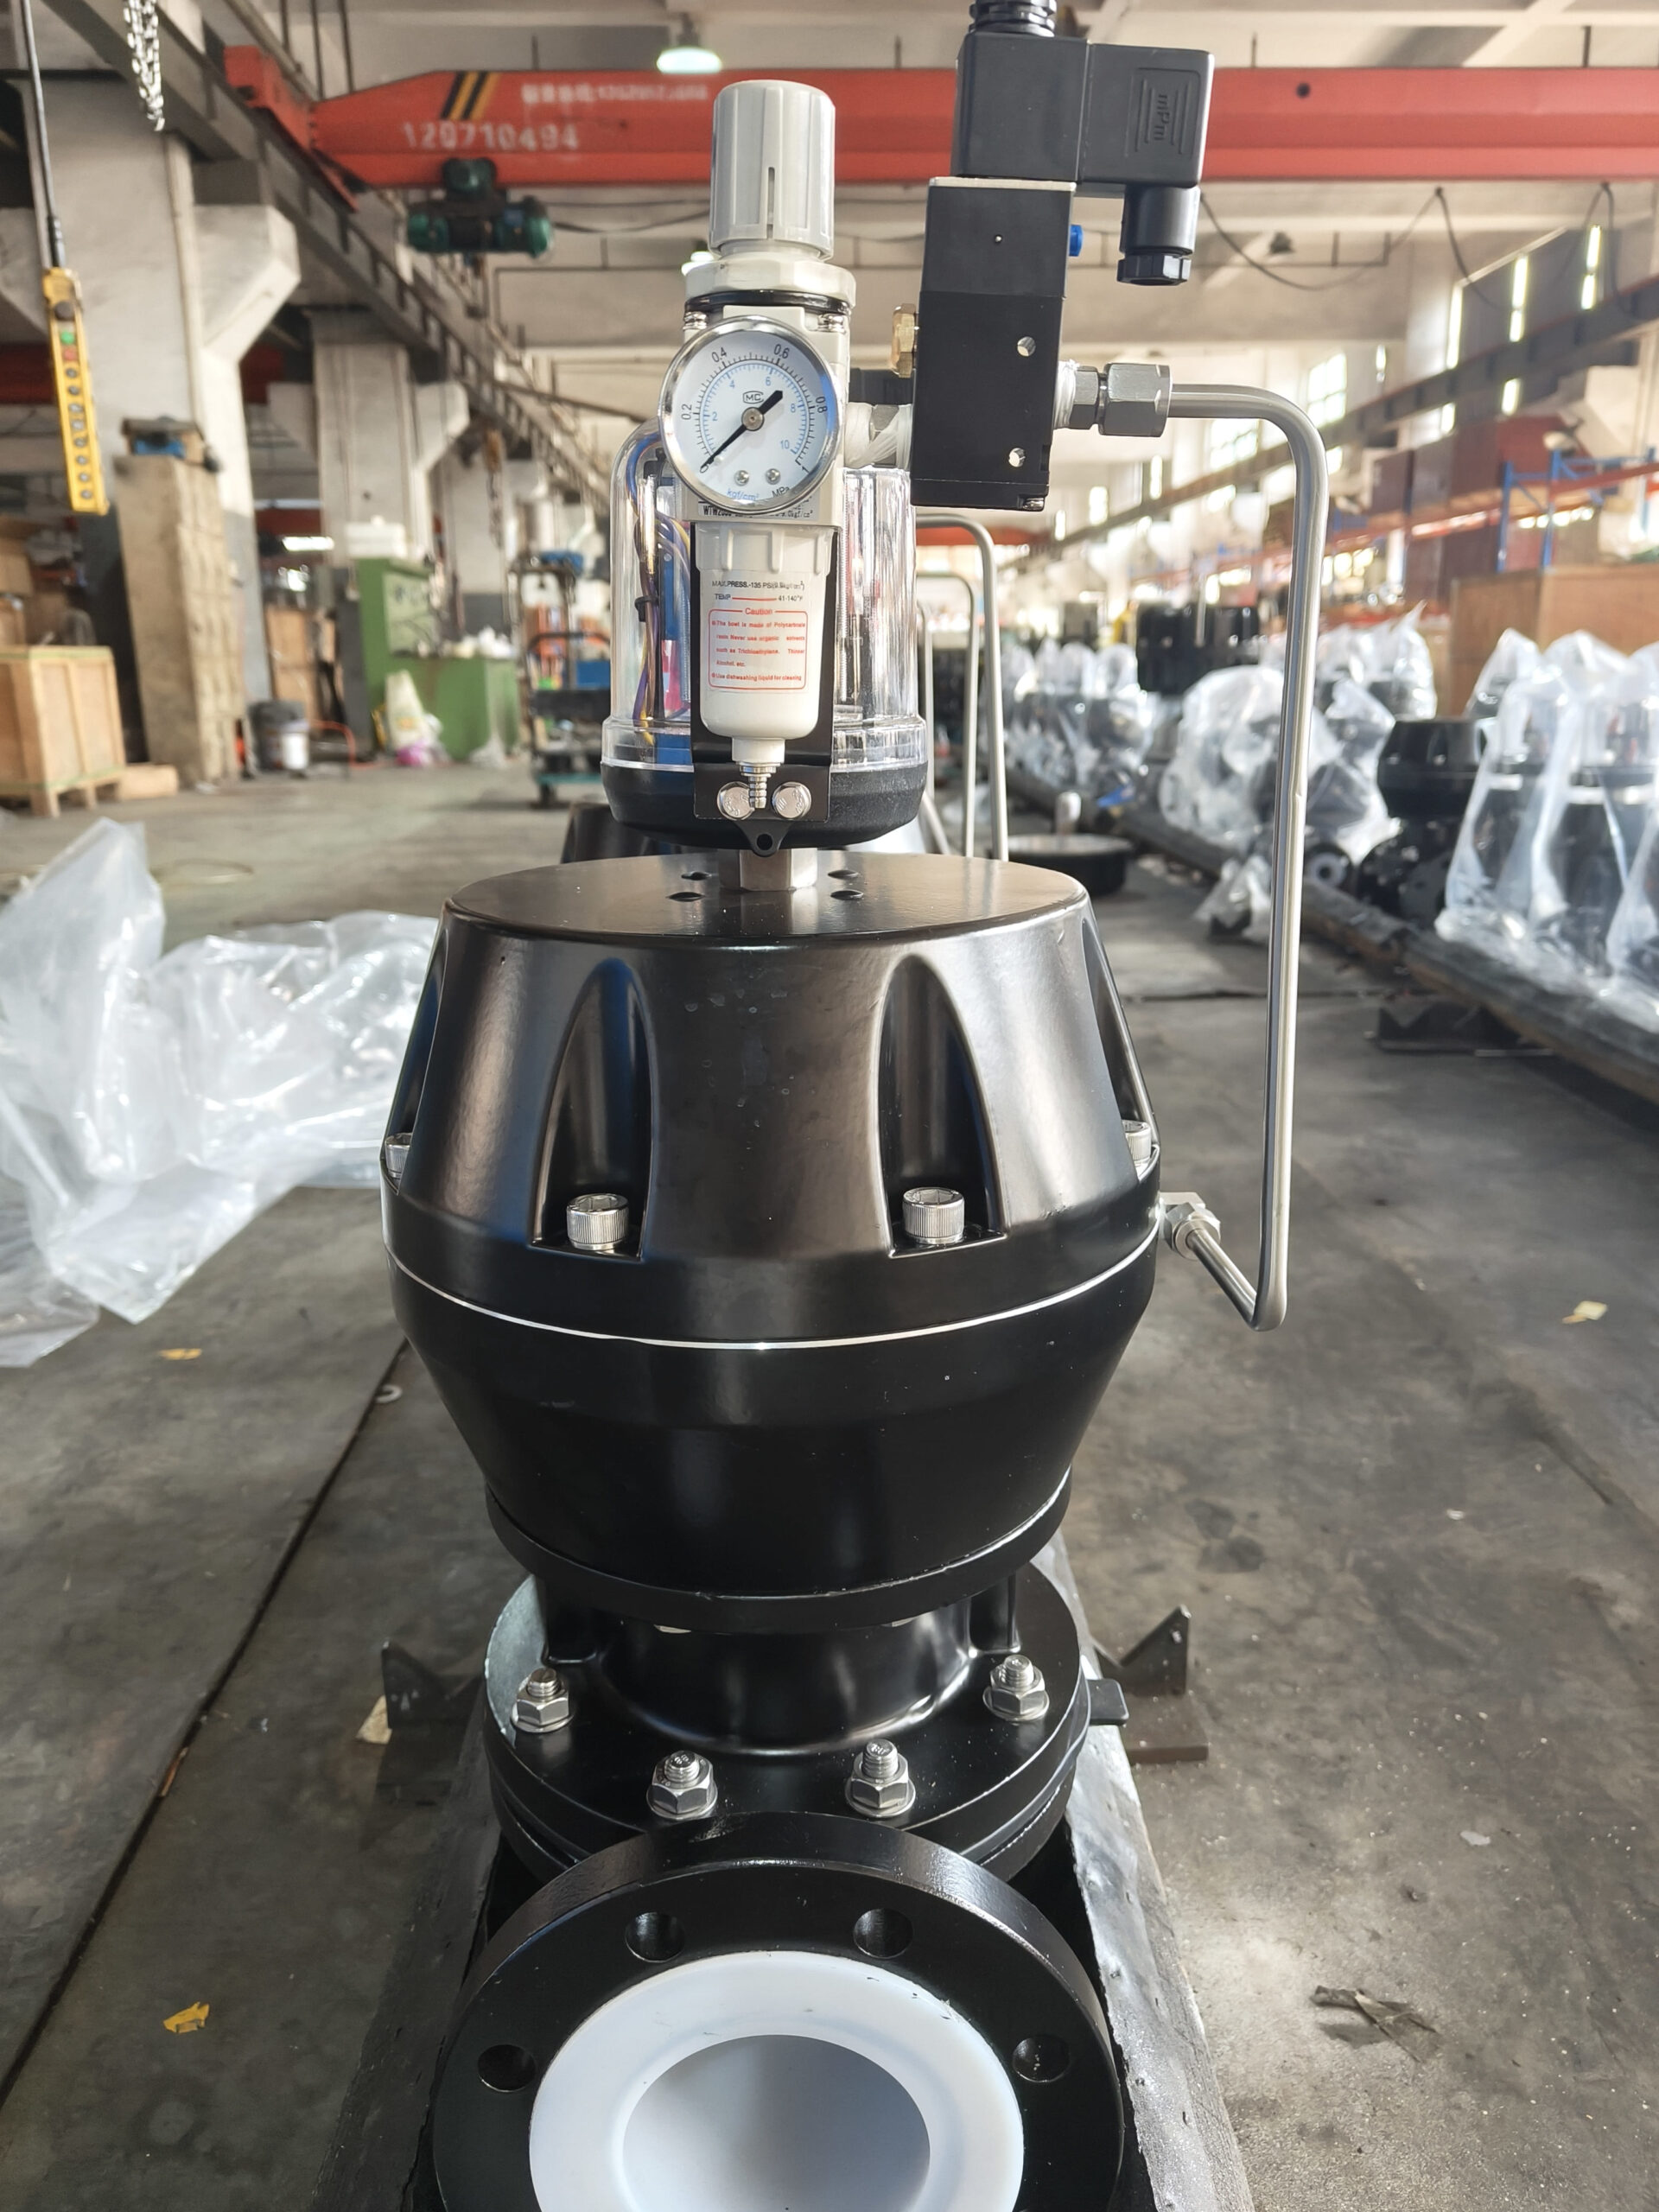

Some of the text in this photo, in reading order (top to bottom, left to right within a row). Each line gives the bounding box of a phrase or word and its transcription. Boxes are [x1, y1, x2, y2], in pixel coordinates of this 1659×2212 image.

[711, 346, 728, 363] 0.4
[773, 343, 790, 359] 0.6
[729, 379, 735, 389] 4
[765, 377, 772, 386] 6
[790, 404, 797, 413] 8
[815, 396, 828, 413] 0.8
[681, 404, 692, 421] 0.2
[712, 411, 718, 422] 2
[780, 439, 790, 449] 10
[801, 466, 810, 474] 1
[745, 607, 772, 615] Caution
[726, 673, 757, 682] dishwashing
